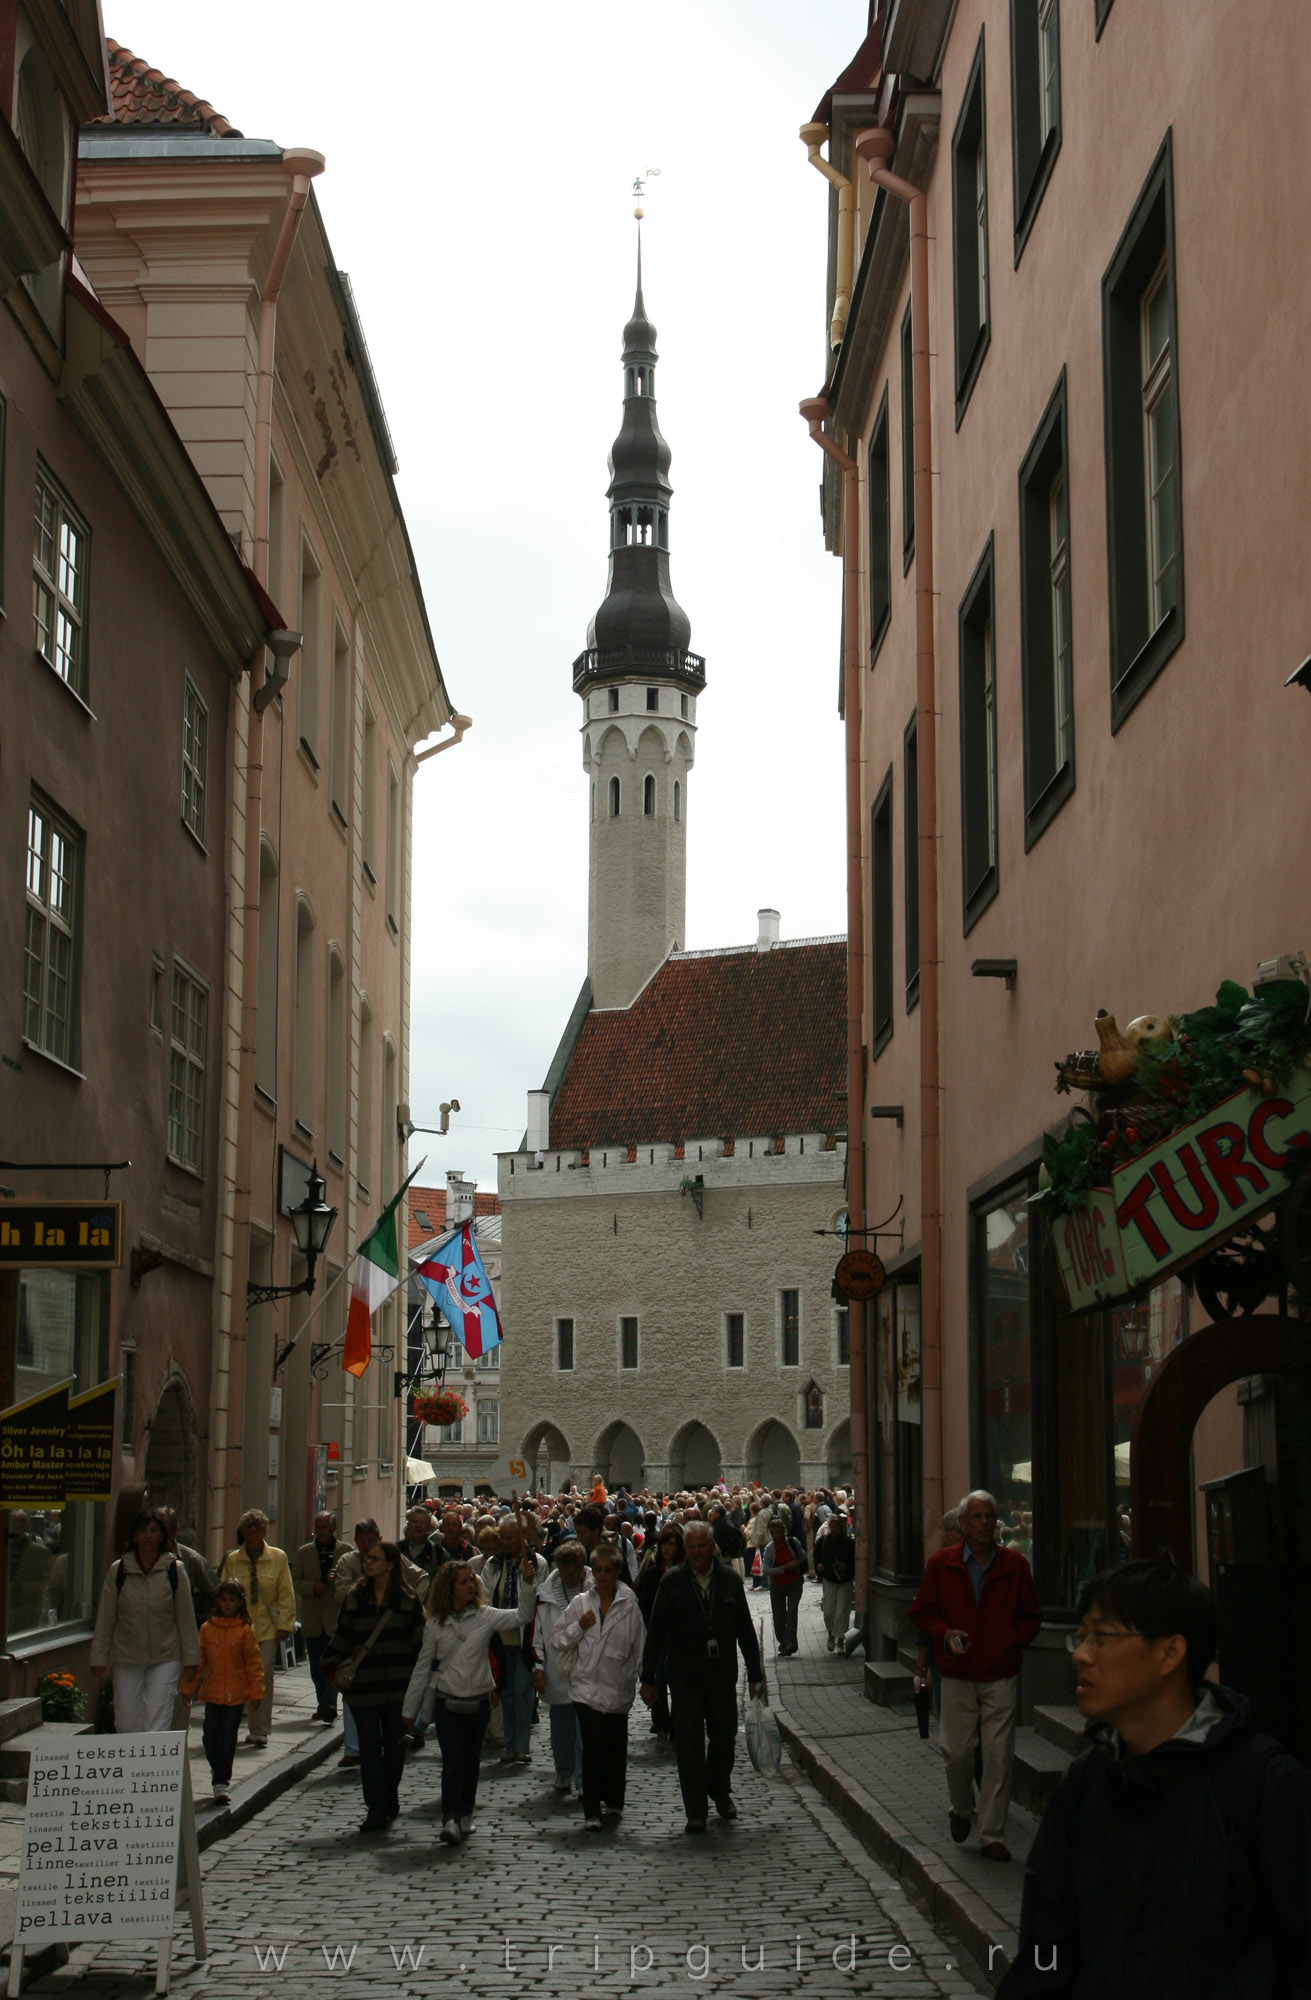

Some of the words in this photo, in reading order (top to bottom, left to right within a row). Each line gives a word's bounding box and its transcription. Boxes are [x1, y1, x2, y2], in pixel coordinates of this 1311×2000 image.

[0, 1221, 20, 1247] h
[34, 1221, 66, 1247] la
[79, 1221, 110, 1247] la
[1, 1425, 28, 1436] Silver
[30, 1425, 66, 1438] Jewelry
[29, 1444, 44, 1458] la
[50, 1444, 65, 1458] la
[78, 1446, 92, 1459] la
[97, 1446, 111, 1459] la
[0, 1460, 30, 1469] Amber
[32, 1460, 65, 1469] Master
[0, 1472, 34, 1480] Souvenir
[35, 1472, 45, 1480] de
[35, 1753, 69, 1762] linased
[76, 1744, 179, 1760] tekstiilid
[33, 1765, 124, 1785] pellava
[131, 1769, 180, 1778] tekstiilit
[32, 1785, 80, 1797] linne
[81, 1788, 125, 1796] textilier
[131, 1782, 179, 1794] linne
[30, 1810, 64, 1818] textile
[70, 1800, 134, 1816] linen
[140, 1806, 175, 1814] textile
[29, 1825, 63, 1833] linased
[70, 1815, 174, 1831] tekstiilid
[26, 1836, 118, 1857] pellava
[126, 1841, 175, 1849] tekstiilit
[25, 1857, 74, 1870] linne
[74, 1859, 119, 1868] textilier
[125, 1853, 174, 1866] linne
[23, 1883, 58, 1891] textile
[64, 1873, 129, 1889] linen
[135, 1878, 170, 1886] textile
[21, 1899, 57, 1907] linased
[64, 1888, 170, 1905] tekstiilid
[19, 1910, 112, 1932] pellava
[120, 1914, 170, 1923] tekstiilit
